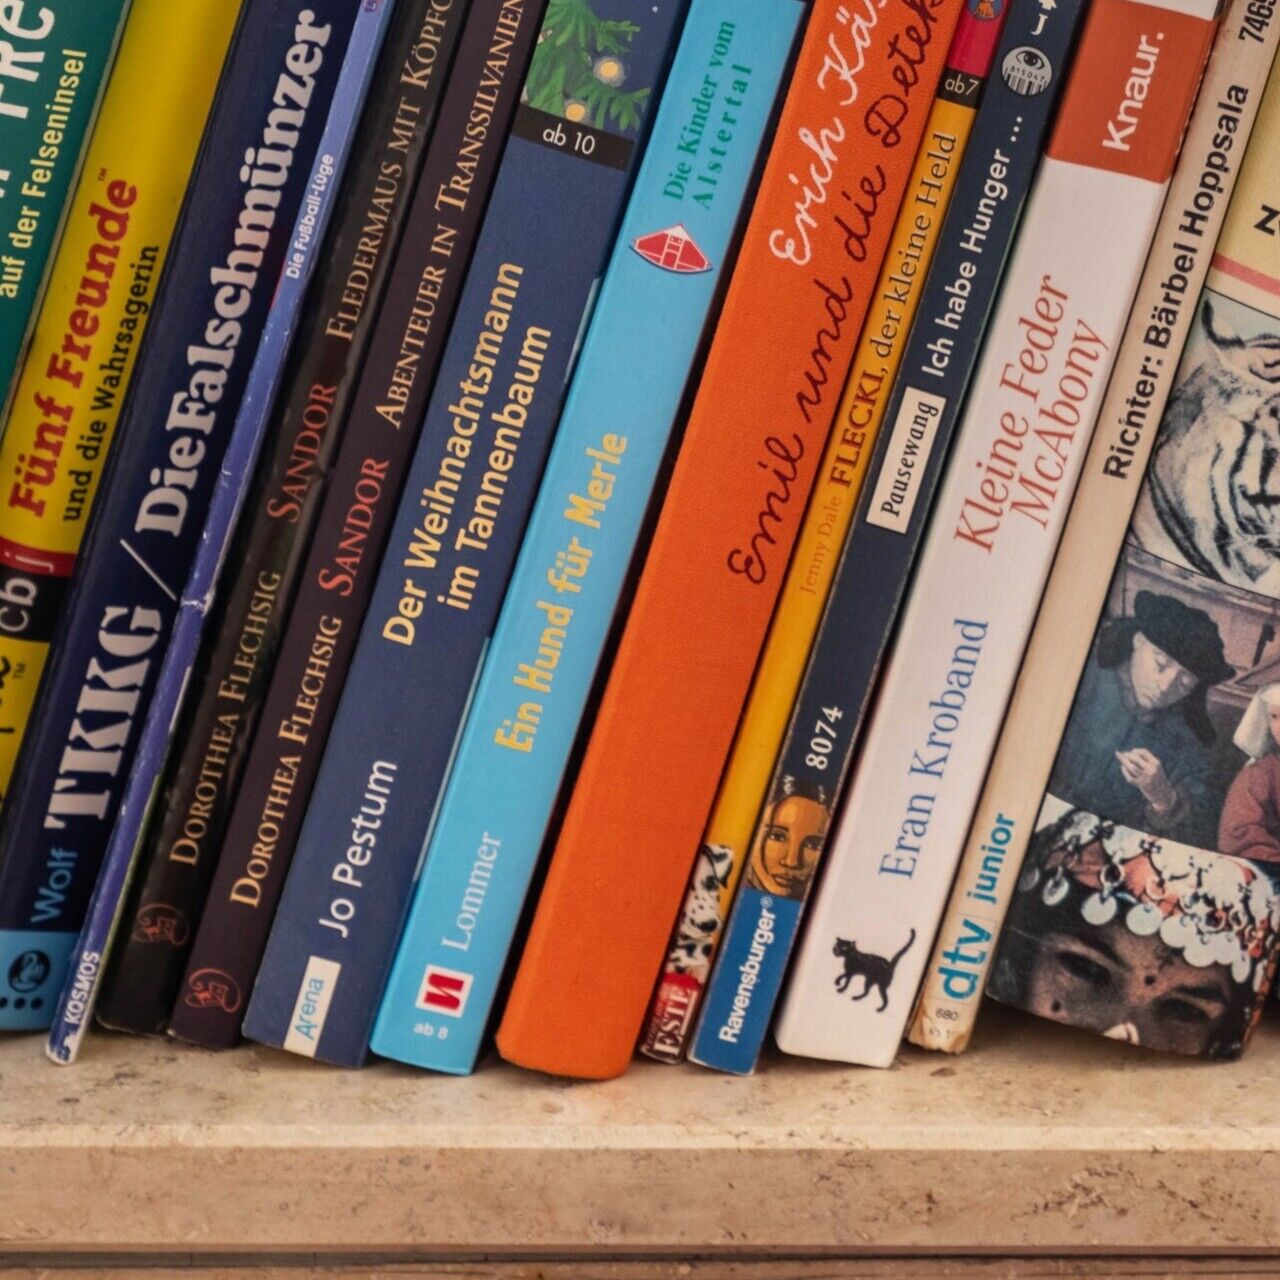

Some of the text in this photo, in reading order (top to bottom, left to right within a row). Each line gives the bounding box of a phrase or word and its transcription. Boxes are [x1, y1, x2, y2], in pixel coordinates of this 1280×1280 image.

[9, 49, 87, 248] der Felseninsel
[662, 21, 736, 201] Die Kinder vom
[1102, 31, 1165, 152] Knaur.
[326, 161, 402, 342] FLEDERMAUS
[770, 117, 846, 267] Erich
[875, 131, 957, 360] der kleine Held
[922, 148, 1011, 379] Ich habe Hunger
[1102, 84, 1248, 480] Richter: Bärbel Hoppsala
[62, 246, 159, 522] und die Wahrsagerin
[375, 265, 447, 429] ABENTEUER
[953, 273, 1070, 555] Kleine Feder
[1009, 318, 1111, 531] McAbony
[8, 391, 73, 518] Fünf
[268, 383, 337, 523] SANDOR
[318, 457, 390, 597] SANDOR
[383, 261, 523, 646] Der Weihnachtsmann
[437, 325, 552, 611] im Tannenbaum
[727, 434, 805, 585] Emil
[881, 400, 939, 518] Pausewang
[494, 432, 628, 752] Ein Hund für Merle
[45, 606, 161, 830] TKKG
[170, 571, 281, 867] DOROTHEA FLECHSIG
[230, 615, 341, 908] DOROTHEA FLECHSIG
[805, 705, 843, 770] 8074
[879, 618, 989, 880] Eran Kroband
[31, 848, 78, 923] Wolf
[320, 759, 398, 938] Jo Pestum
[442, 831, 500, 952] Lommer
[64, 950, 100, 1025] KOSMOS
[294, 976, 324, 1040] Arena
